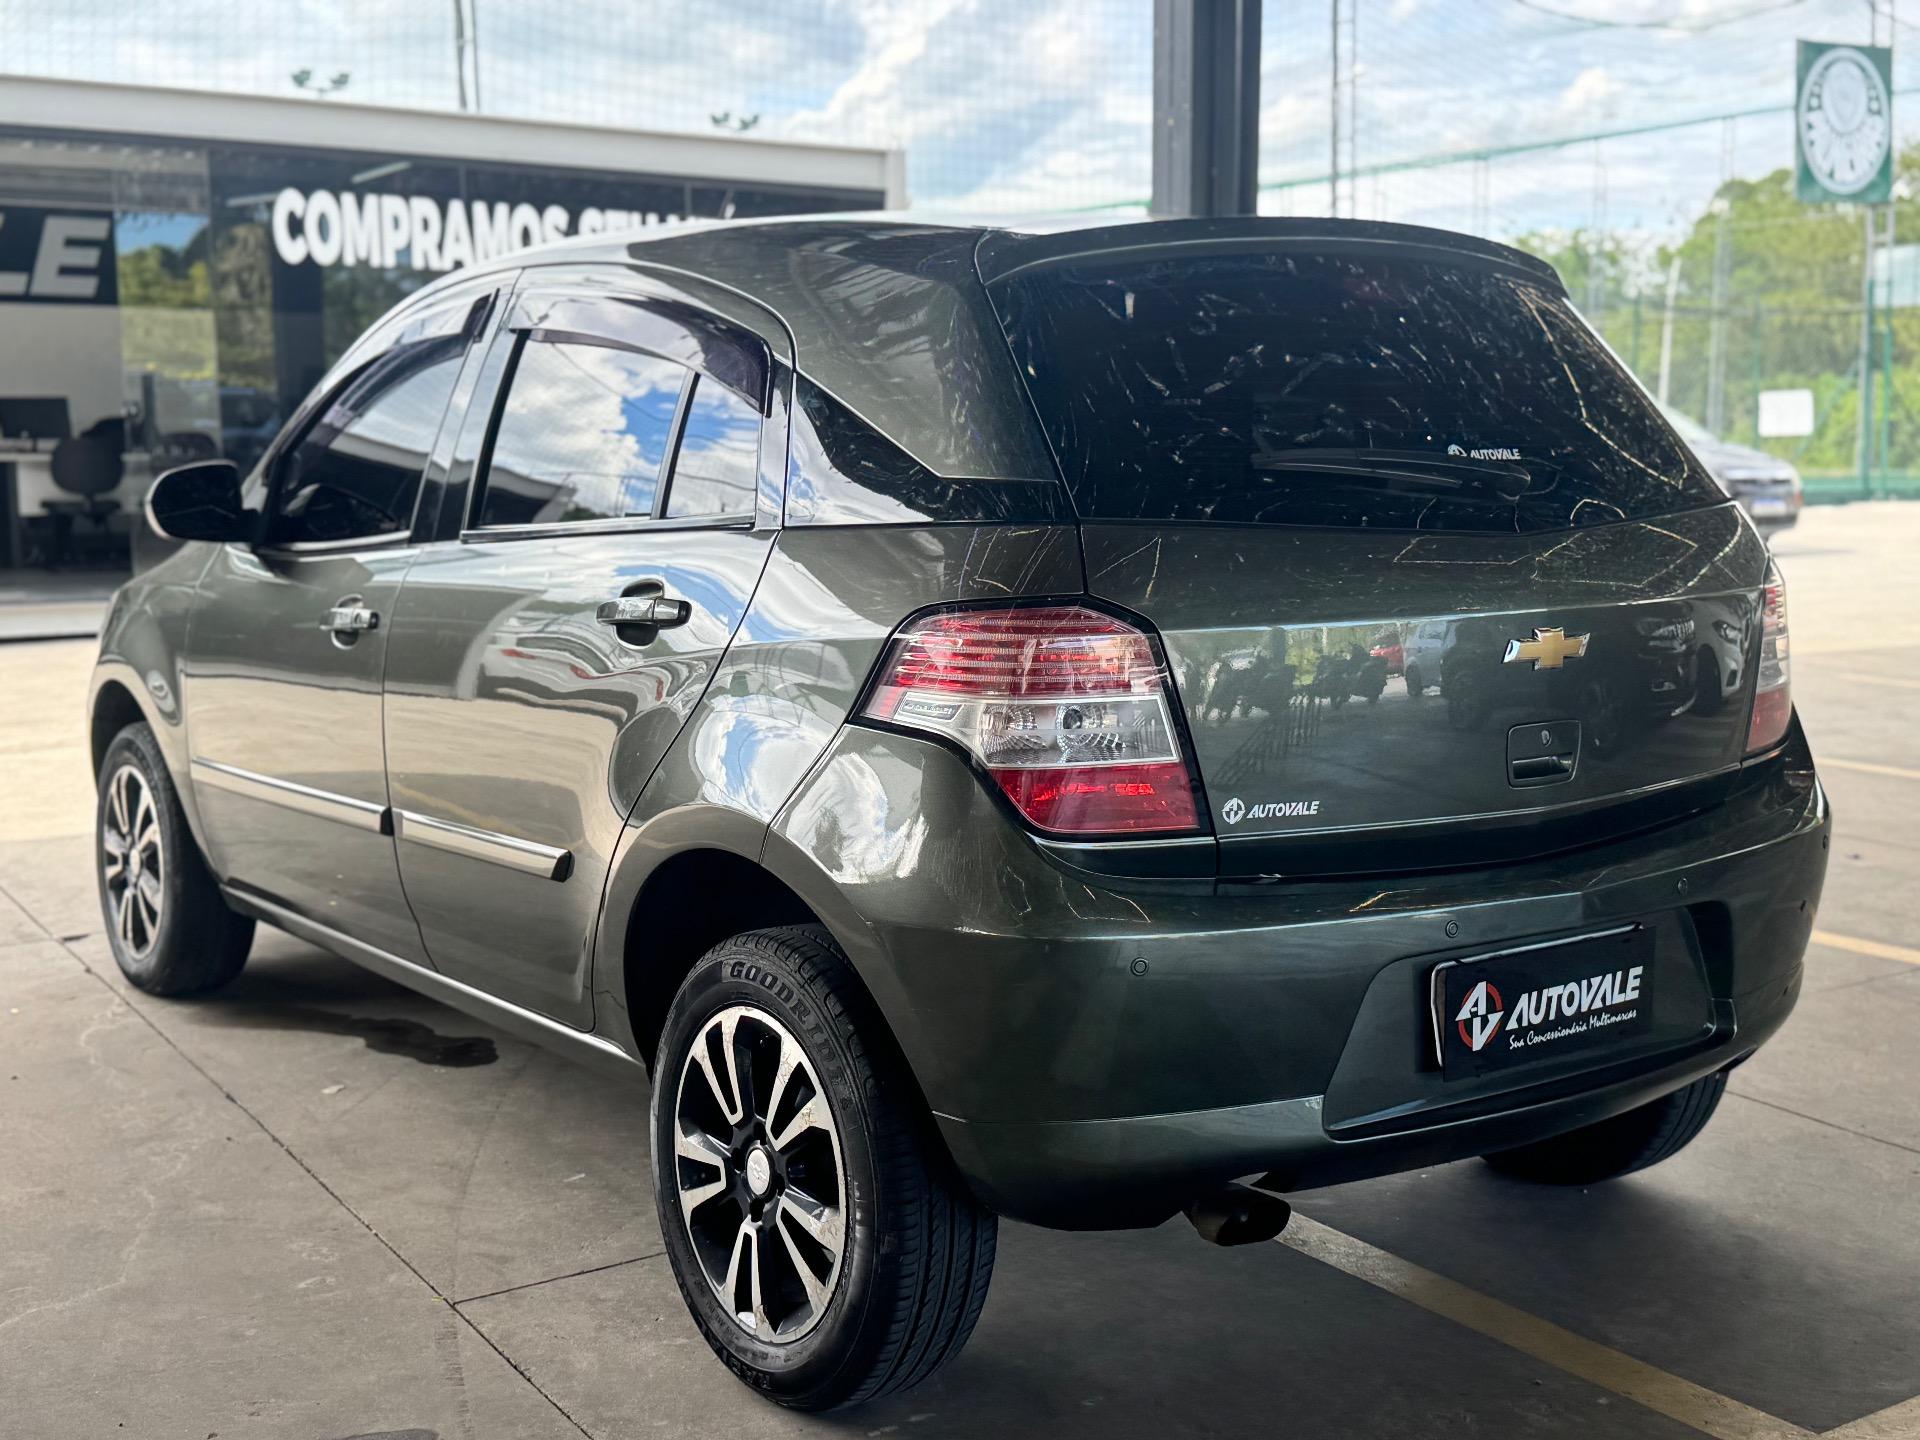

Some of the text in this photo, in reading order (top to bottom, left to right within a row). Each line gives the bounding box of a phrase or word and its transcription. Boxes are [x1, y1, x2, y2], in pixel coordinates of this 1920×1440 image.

[272, 187, 569, 270] COMPRAMOS
[1470, 448, 1521, 460] AUTOVALE
[1246, 800, 1320, 819] AUTOVALE
[1505, 965, 1643, 1031] AUTOVALE
[1509, 1009, 1637, 1050] Sua Concessionária Multimarcas
